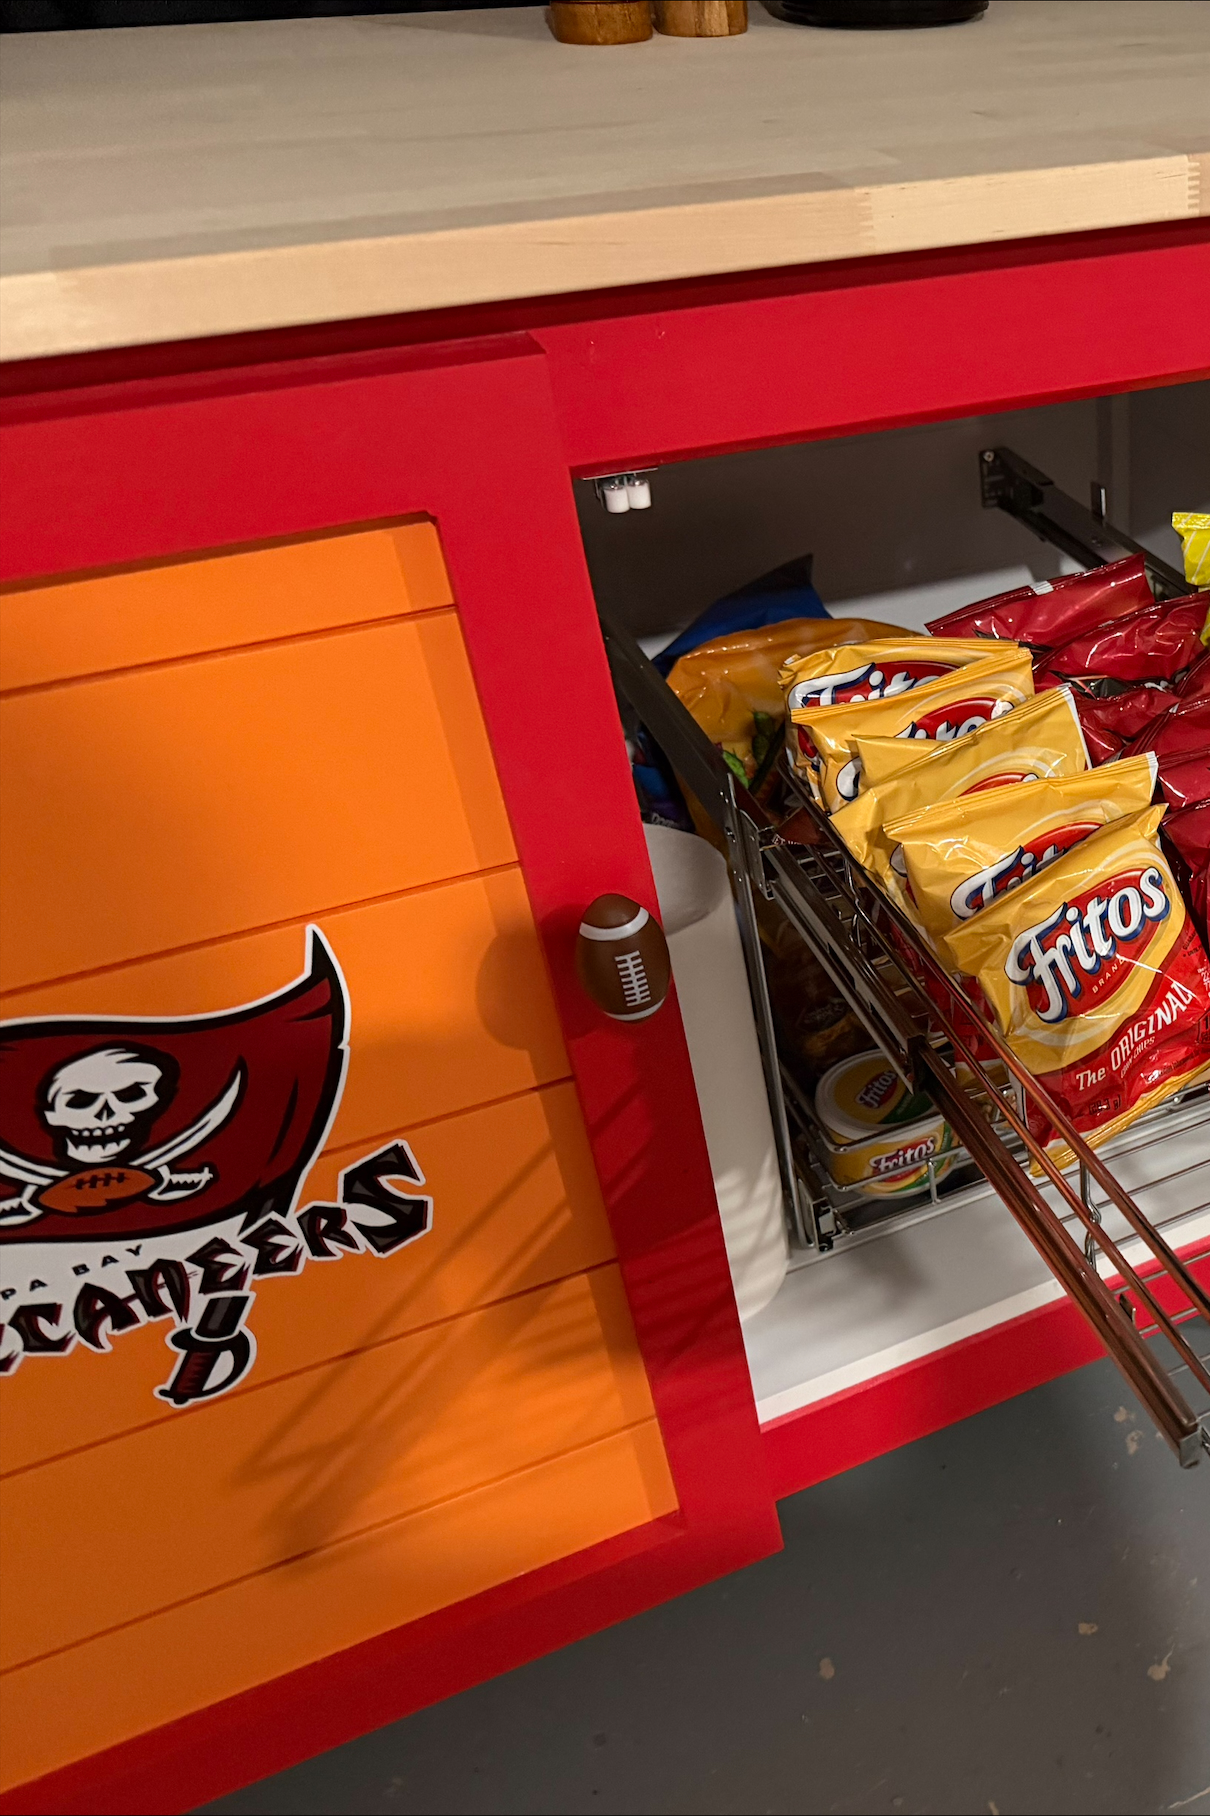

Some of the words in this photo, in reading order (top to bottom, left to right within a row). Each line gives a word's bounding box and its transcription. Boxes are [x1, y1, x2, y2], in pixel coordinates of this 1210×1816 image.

[1004, 866, 1170, 1023] Fritos
[1075, 1067, 1107, 1091] The
[1110, 981, 1197, 1071] ORIGINAL
[1133, 1036, 1156, 1059] CHIPS
[855, 1069, 898, 1109] Fritos
[868, 1136, 935, 1173] Fritos
[0, 1143, 428, 1373] CANEERS
[71, 1243, 143, 1277] BAY
